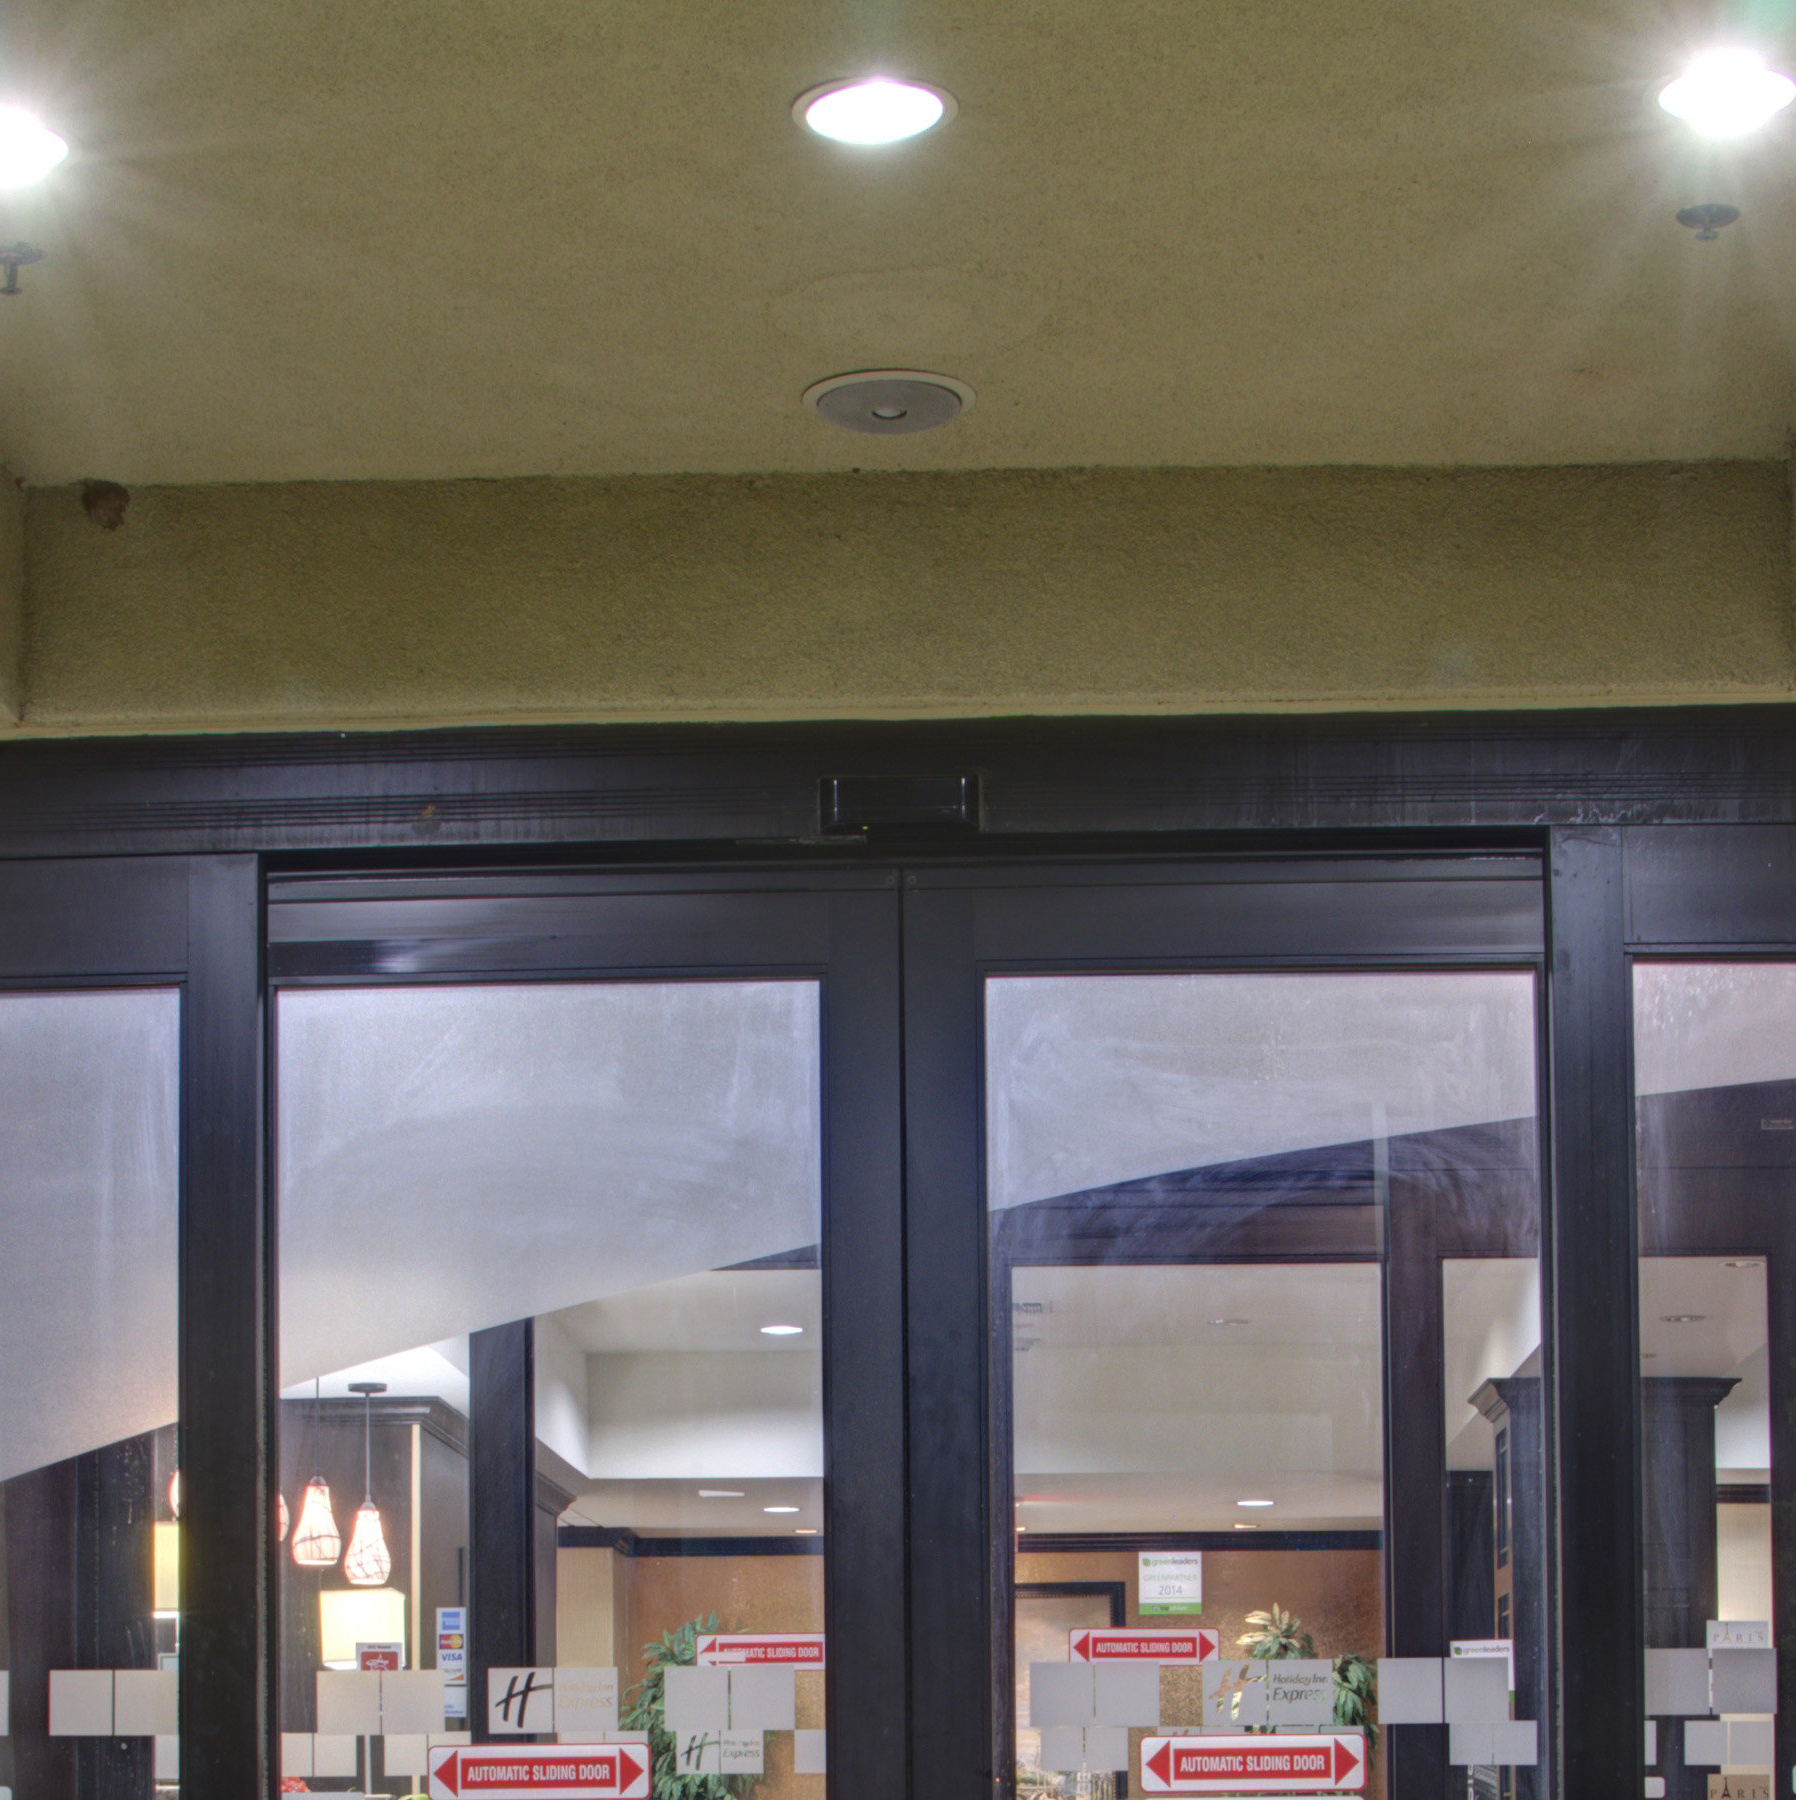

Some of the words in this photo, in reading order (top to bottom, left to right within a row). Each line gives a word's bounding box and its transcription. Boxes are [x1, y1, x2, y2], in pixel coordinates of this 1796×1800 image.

[1158, 1584, 1183, 1596] 2014
[766, 1647, 797, 1658] SLIDING
[797, 1647, 820, 1658] DOOR
[1096, 1642, 1139, 1653] AUTOMATIC
[1140, 1642, 1170, 1653] SLIDING
[1171, 1641, 1193, 1653] DOOR
[441, 1653, 463, 1661] VISA
[1179, 1757, 1244, 1772] AUTOMATIC
[1246, 1756, 1291, 1771] SLIDING
[1293, 1755, 1325, 1770] DOOR
[467, 1765, 530, 1782] AUTOMATIC
[532, 1765, 576, 1781] SLIDING
[579, 1764, 611, 1780] DOOR
